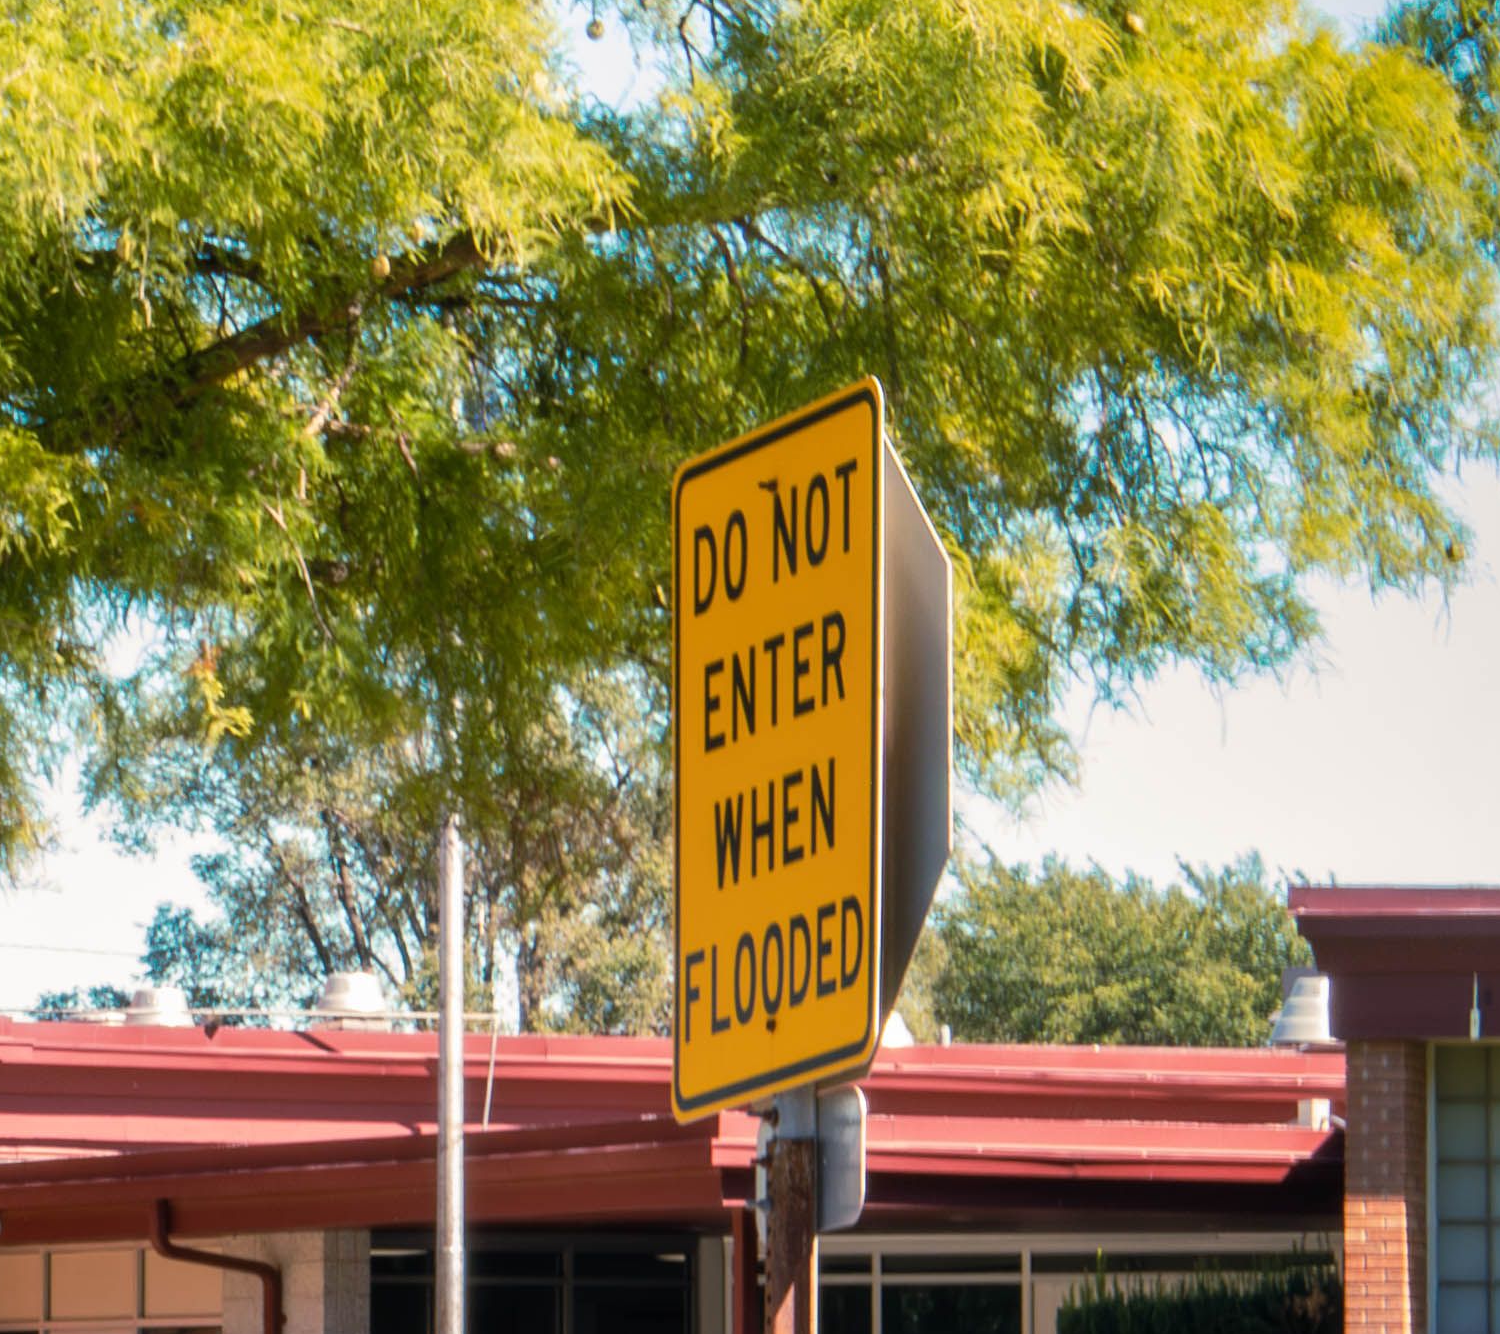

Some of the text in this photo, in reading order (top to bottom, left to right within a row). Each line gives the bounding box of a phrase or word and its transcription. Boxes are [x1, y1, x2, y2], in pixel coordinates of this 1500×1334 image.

[693, 459, 858, 616] DO NOT
[703, 609, 846, 753] ENTER
[713, 757, 836, 889] WHEN
[684, 895, 864, 1043] FLOODED
